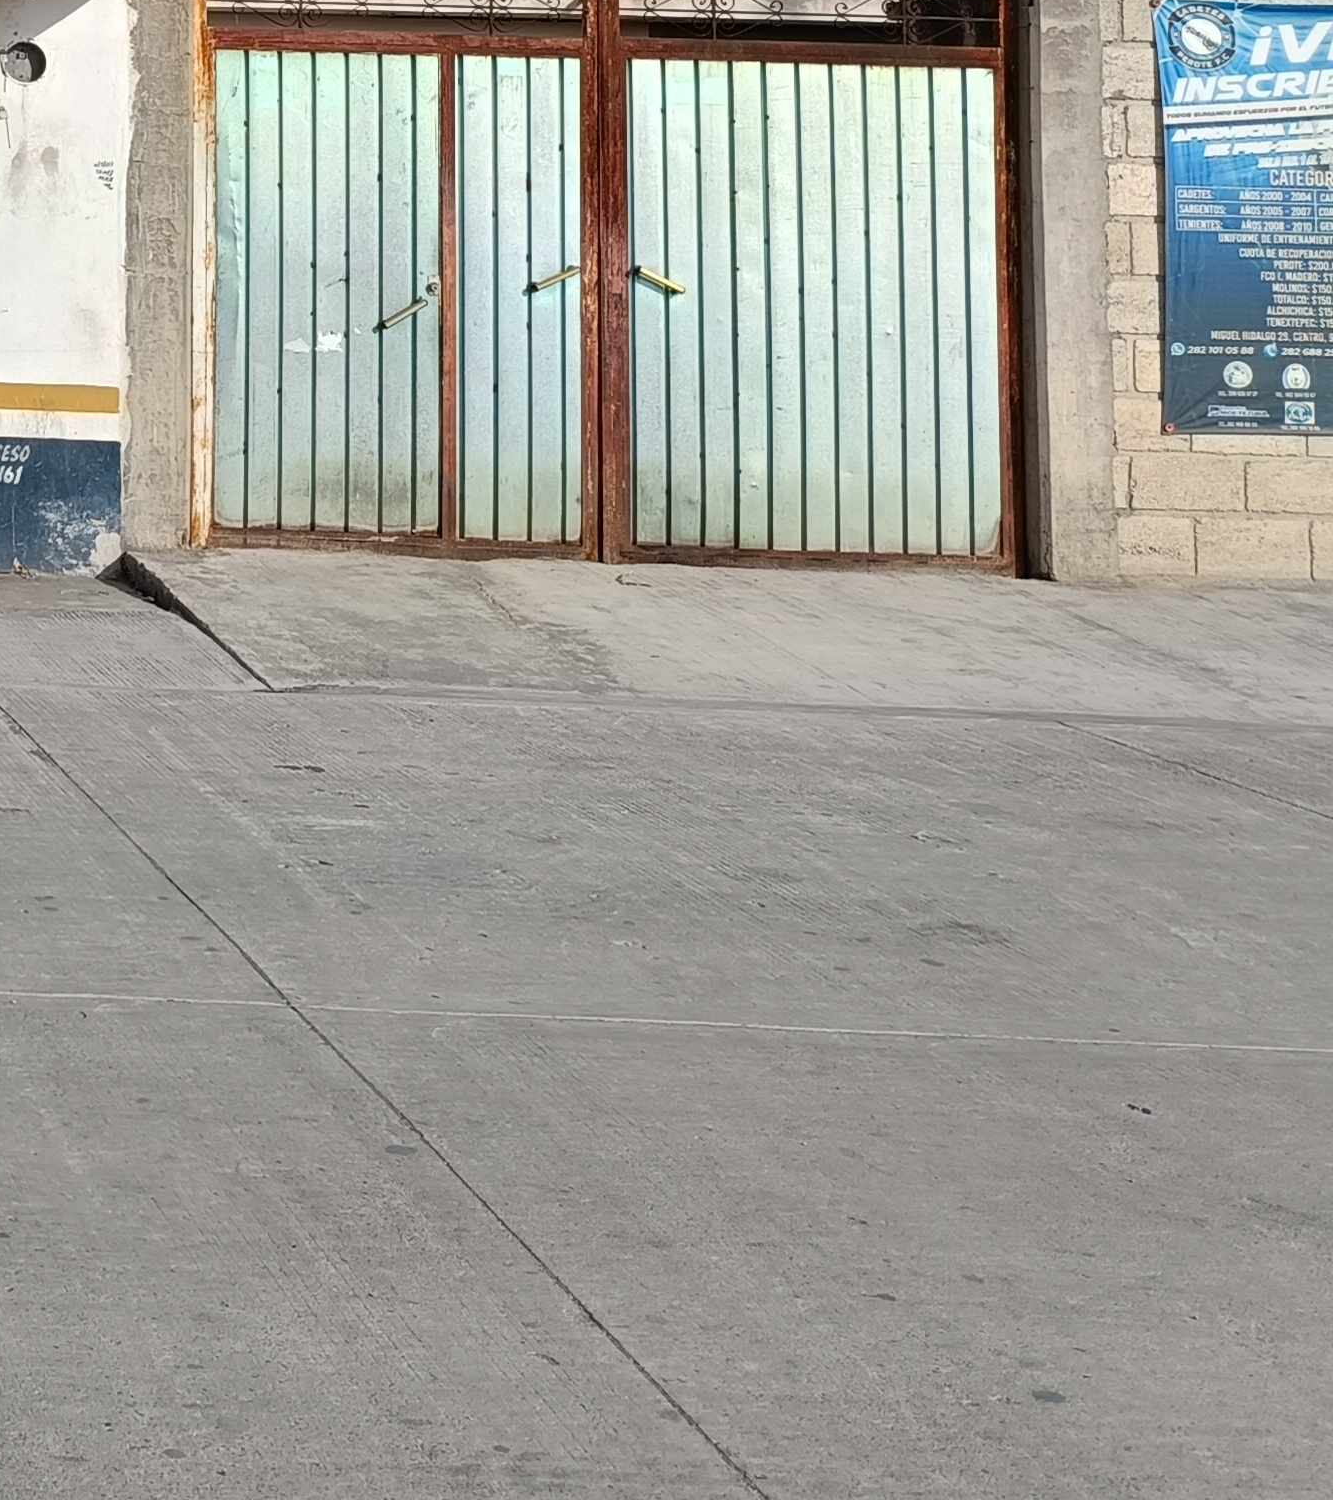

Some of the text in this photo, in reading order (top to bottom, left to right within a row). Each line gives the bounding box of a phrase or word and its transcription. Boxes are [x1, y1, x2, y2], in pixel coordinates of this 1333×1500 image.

[1176, 4, 1226, 20] CADETES
[1176, 50, 1213, 68] PEROTE
[1233, 107, 1278, 116] ESFUERZOS
[1288, 122, 1314, 134] LA
[1178, 189, 1214, 200] CADETES:
[1240, 189, 1260, 200] AÑOS
[1262, 191, 1283, 201] 2000
[1290, 192, 1312, 201] 2004
[1178, 204, 1227, 214] SARGENTOS:
[1240, 204, 1261, 215] AÑOS
[1262, 206, 1283, 215] 2005
[1291, 206, 1312, 216] 2007
[1178, 219, 1224, 230] TENIENTES:
[1241, 219, 1262, 231] AÑOS
[1292, 222, 1312, 232] 2010
[1218, 233, 1259, 243] UNIFORME
[1261, 234, 1271, 243] DE
[1239, 248, 1265, 258] CUOTA
[1266, 248, 1276, 258] DE
[1274, 260, 1306, 270] PEROTE:
[1260, 271, 1276, 280] FCO
[1286, 272, 1321, 282] MADERO:
[1272, 284, 1310, 293] MOLINOS:
[1272, 295, 1310, 304] TOTALCO:
[1267, 306, 1317, 316] ALCHICHICA:
[1266, 317, 1318, 327] TENEXTEPEC:
[1211, 330, 1241, 340] MIGUEL
[1242, 331, 1276, 340] HIDALGO
[1187, 346, 1206, 354] 282
[1225, 346, 1238, 354] 05
[1240, 347, 1254, 355] 88
